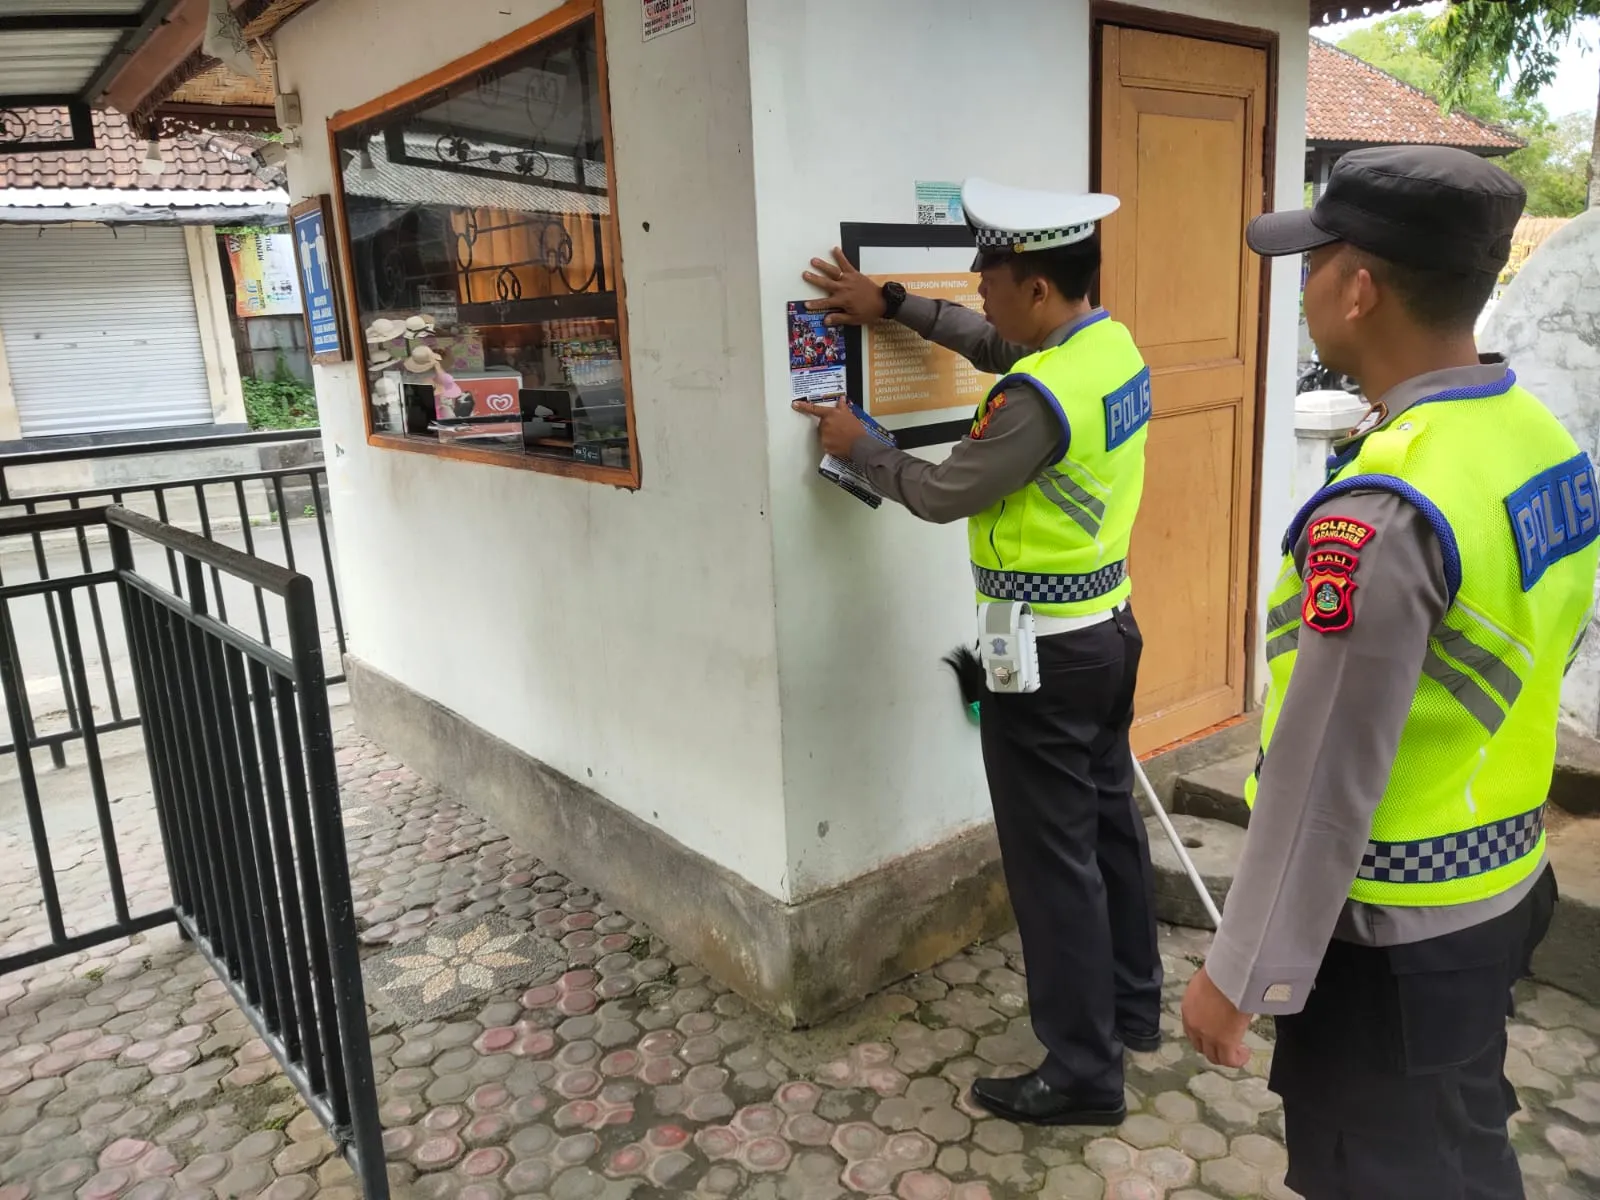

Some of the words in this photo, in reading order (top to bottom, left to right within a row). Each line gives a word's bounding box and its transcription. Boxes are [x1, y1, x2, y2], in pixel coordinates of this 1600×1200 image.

[940, 280, 969, 288] PENTING
[1110, 379, 1150, 441] POLIS
[1312, 520, 1367, 538] POLRES
[1313, 530, 1361, 545] KARANGASEM
[1316, 554, 1347, 565] BALI
